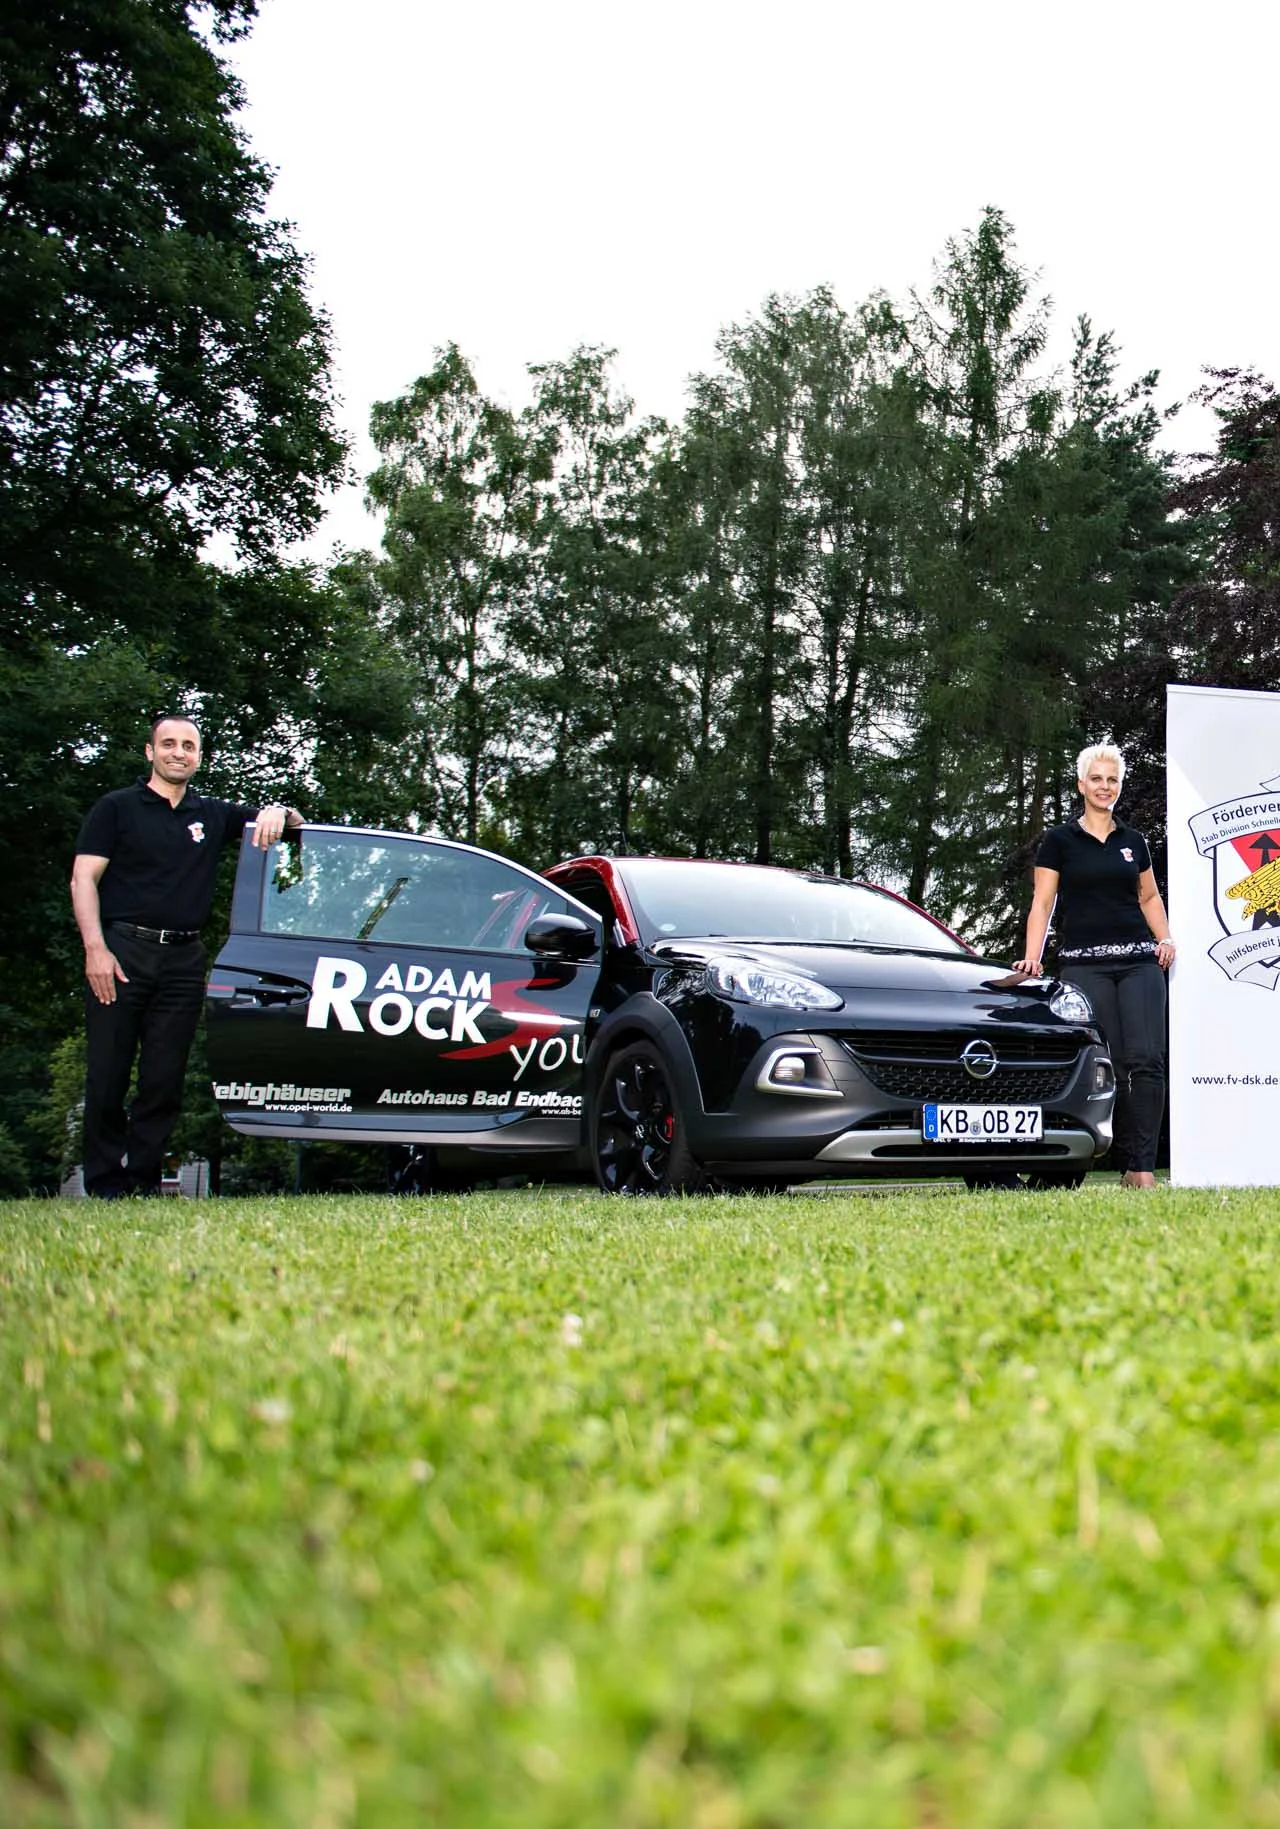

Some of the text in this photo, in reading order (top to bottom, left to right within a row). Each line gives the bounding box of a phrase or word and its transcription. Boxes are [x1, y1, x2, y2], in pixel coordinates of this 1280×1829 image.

[1201, 832, 1219, 844] Stab
[1219, 825, 1250, 836] Division
[1226, 938, 1275, 963] hilfsbereit
[375, 963, 492, 1000] ADAM
[306, 956, 491, 1044] ROCK
[1191, 1075, 1279, 1085] www.fv-dsk.de
[377, 1089, 468, 1105] Autohaus
[472, 1091, 510, 1106] Bad
[940, 1110, 969, 1134] KB
[982, 1110, 1010, 1134] OB
[1014, 1111, 1039, 1134] 27
